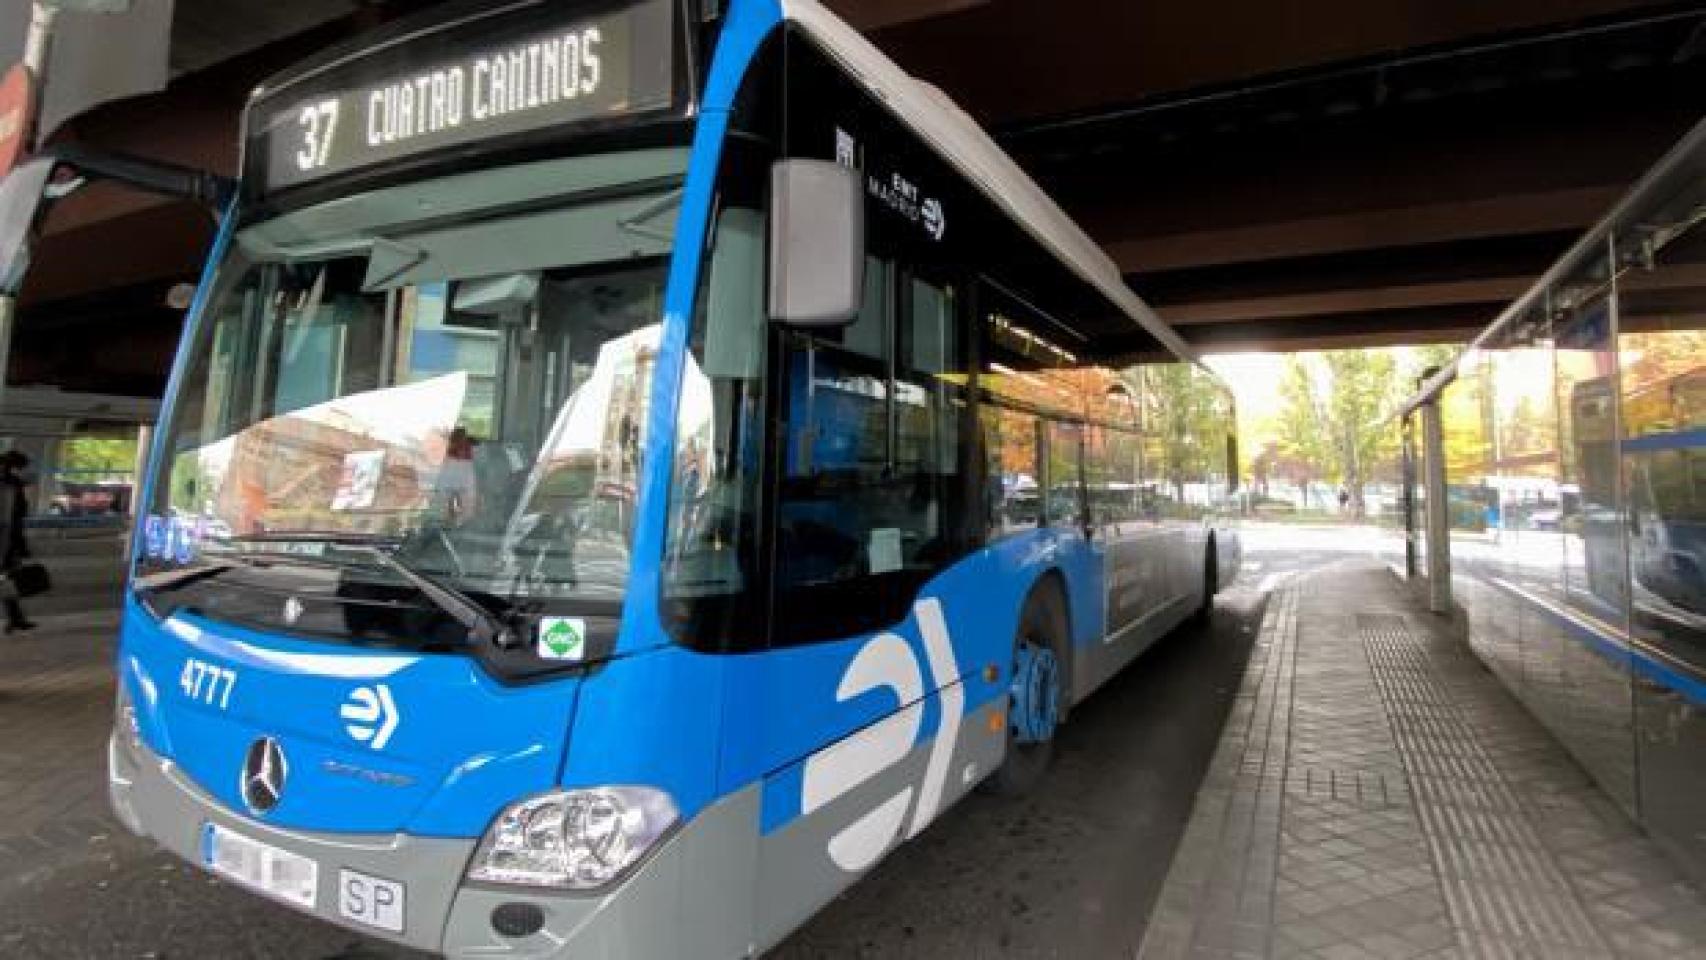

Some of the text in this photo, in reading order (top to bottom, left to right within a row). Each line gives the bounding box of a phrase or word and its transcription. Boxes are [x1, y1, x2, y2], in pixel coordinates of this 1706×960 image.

[297, 28, 600, 170] 37 CUATRO CAMINOS
[180, 658, 237, 710] 4777
[348, 879, 395, 920] SP
